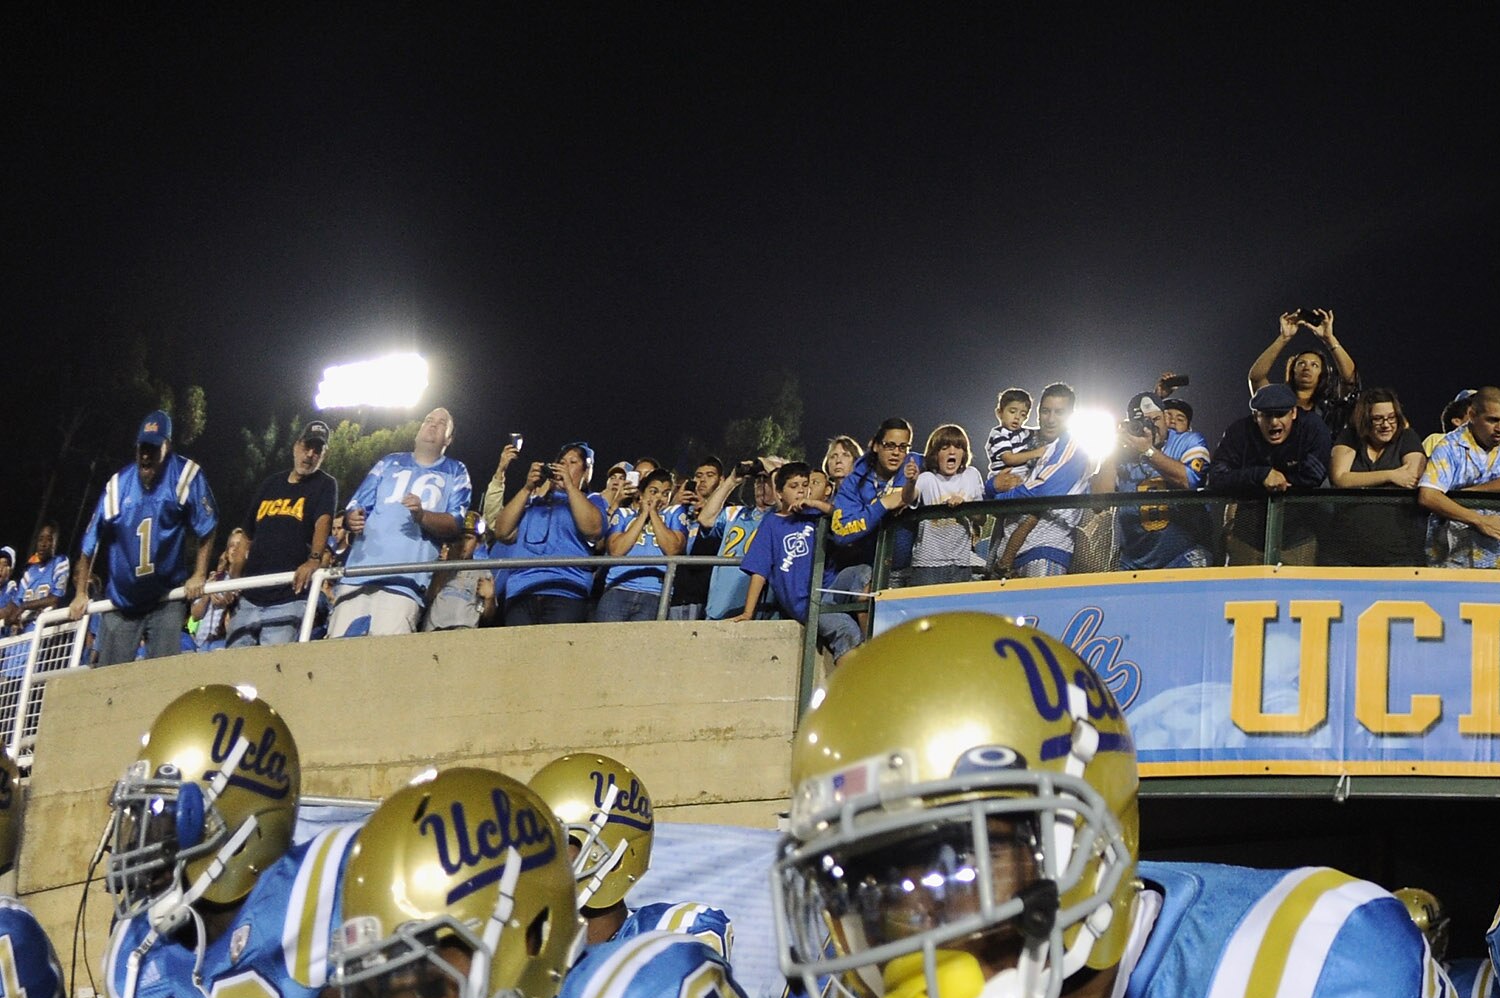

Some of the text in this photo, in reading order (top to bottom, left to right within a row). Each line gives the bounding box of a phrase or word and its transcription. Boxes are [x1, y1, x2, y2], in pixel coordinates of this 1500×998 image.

[256, 497, 306, 521] UCLA
[385, 469, 446, 511] 16
[135, 517, 155, 577] 1
[993, 635, 1130, 761] Uc
[202, 712, 290, 800] Ucla
[590, 770, 653, 831] Ucla
[419, 788, 557, 906] Ucla
